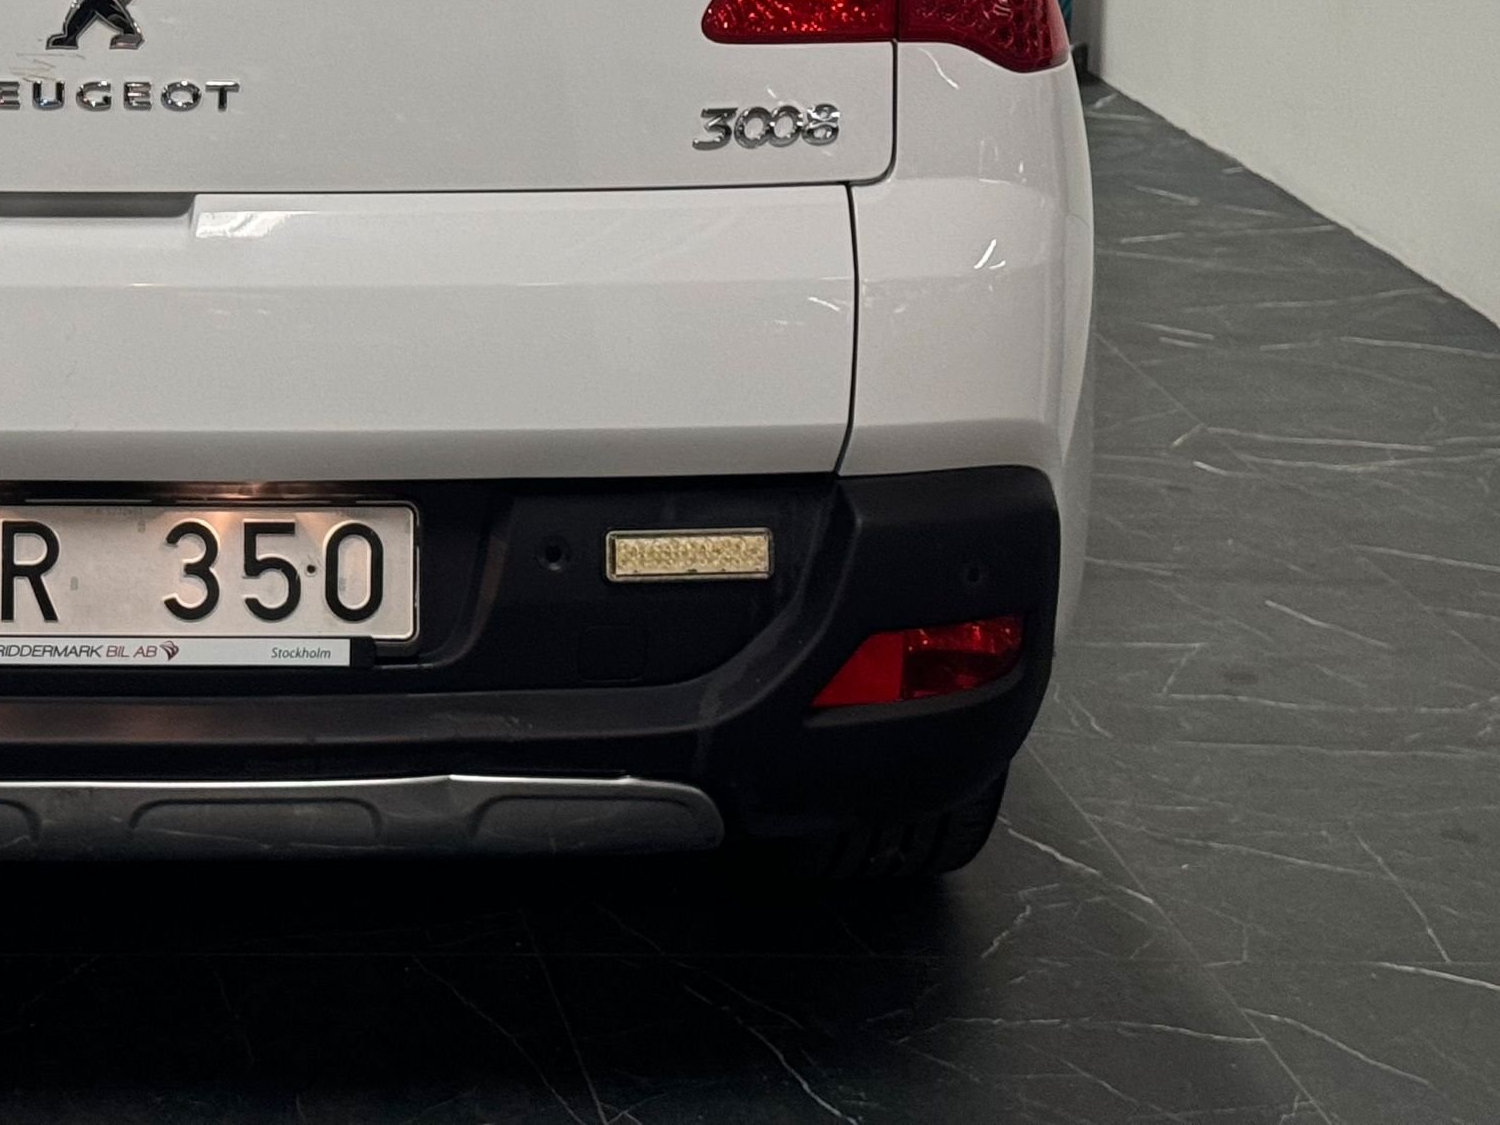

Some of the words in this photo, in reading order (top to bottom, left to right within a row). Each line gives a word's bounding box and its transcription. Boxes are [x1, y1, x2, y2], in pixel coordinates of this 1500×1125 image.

[692, 103, 841, 150] 3008
[163, 520, 385, 623] 350
[105, 645, 130, 658] BIL
[132, 645, 158, 658] AB
[271, 646, 332, 660] Stockholm
